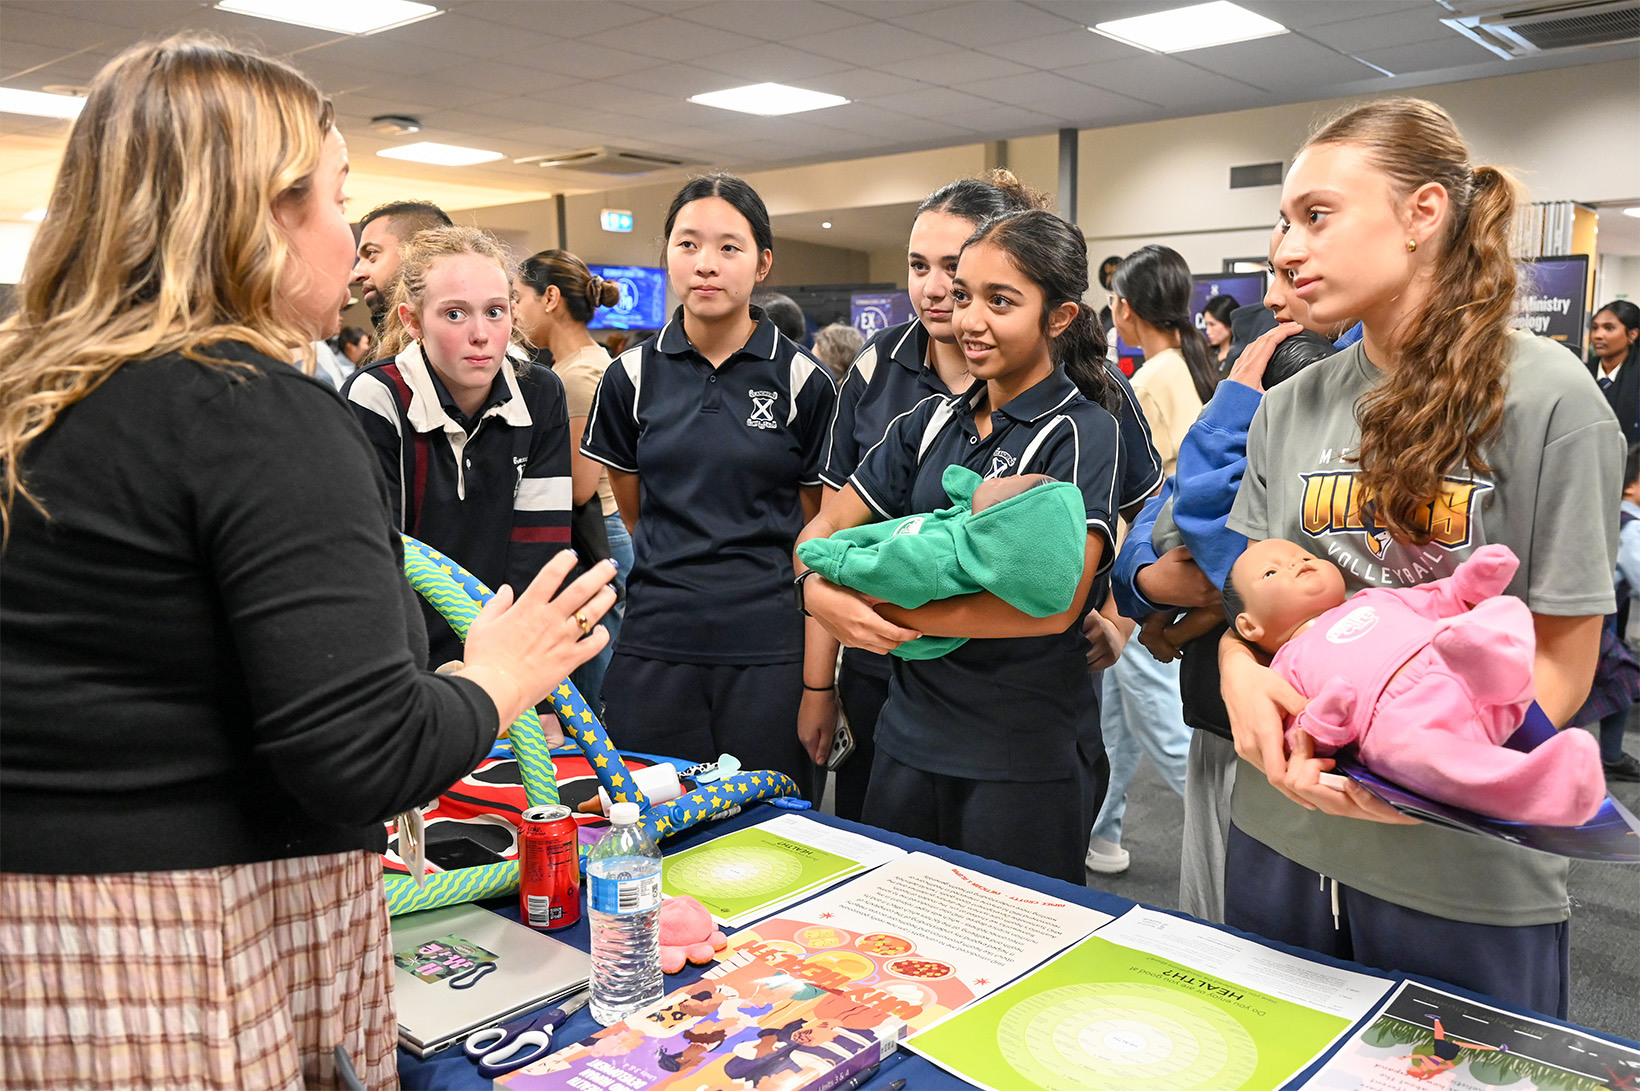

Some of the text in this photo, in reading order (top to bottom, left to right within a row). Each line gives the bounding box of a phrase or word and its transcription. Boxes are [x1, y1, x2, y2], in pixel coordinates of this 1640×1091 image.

[1521, 295, 1571, 315] Ministry
[734, 940, 850, 987] HEALTH
[1138, 968, 1162, 980] good
[1162, 968, 1244, 1002] HEALTH?
[1164, 976, 1182, 988] you
[1182, 985, 1196, 993] are
[1207, 992, 1232, 1005] enjoy
[1234, 1002, 1254, 1013] you
[1254, 1009, 1266, 1018] Do
[586, 1059, 648, 1090] DEVELOPMENT
